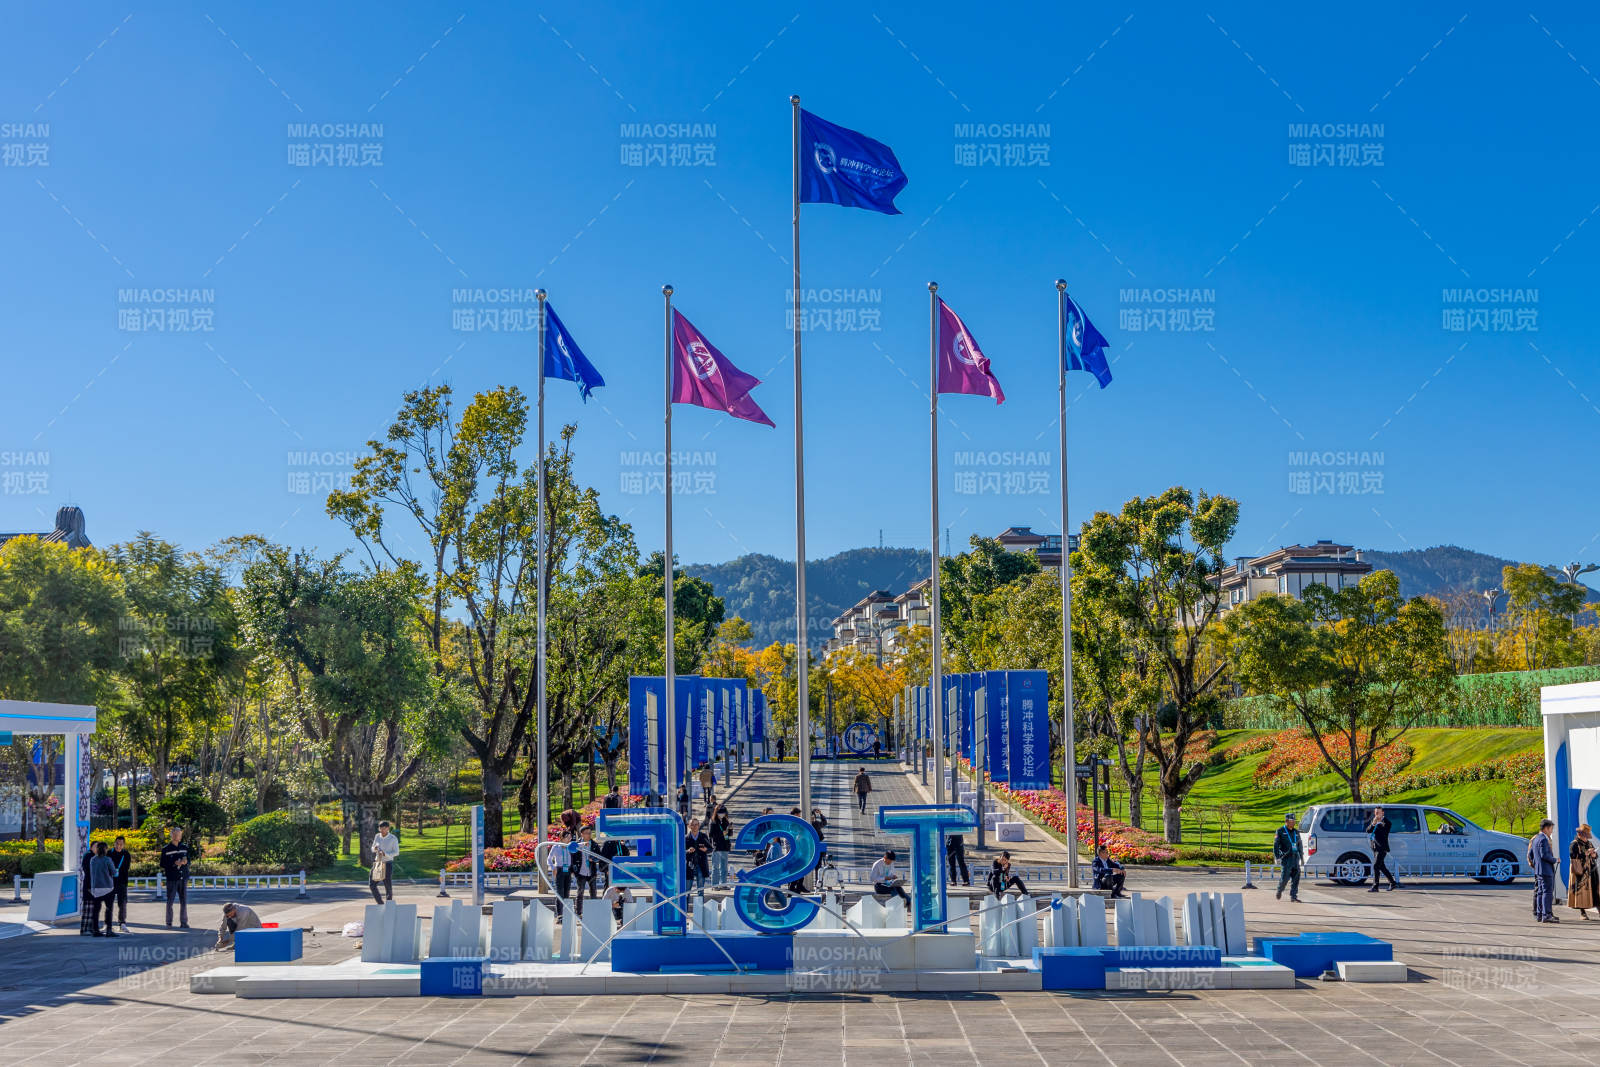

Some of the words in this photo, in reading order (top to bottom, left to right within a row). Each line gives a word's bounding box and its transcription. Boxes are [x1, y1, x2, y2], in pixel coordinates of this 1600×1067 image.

[1022, 699, 1034, 777] 腾冲科学家论坛
